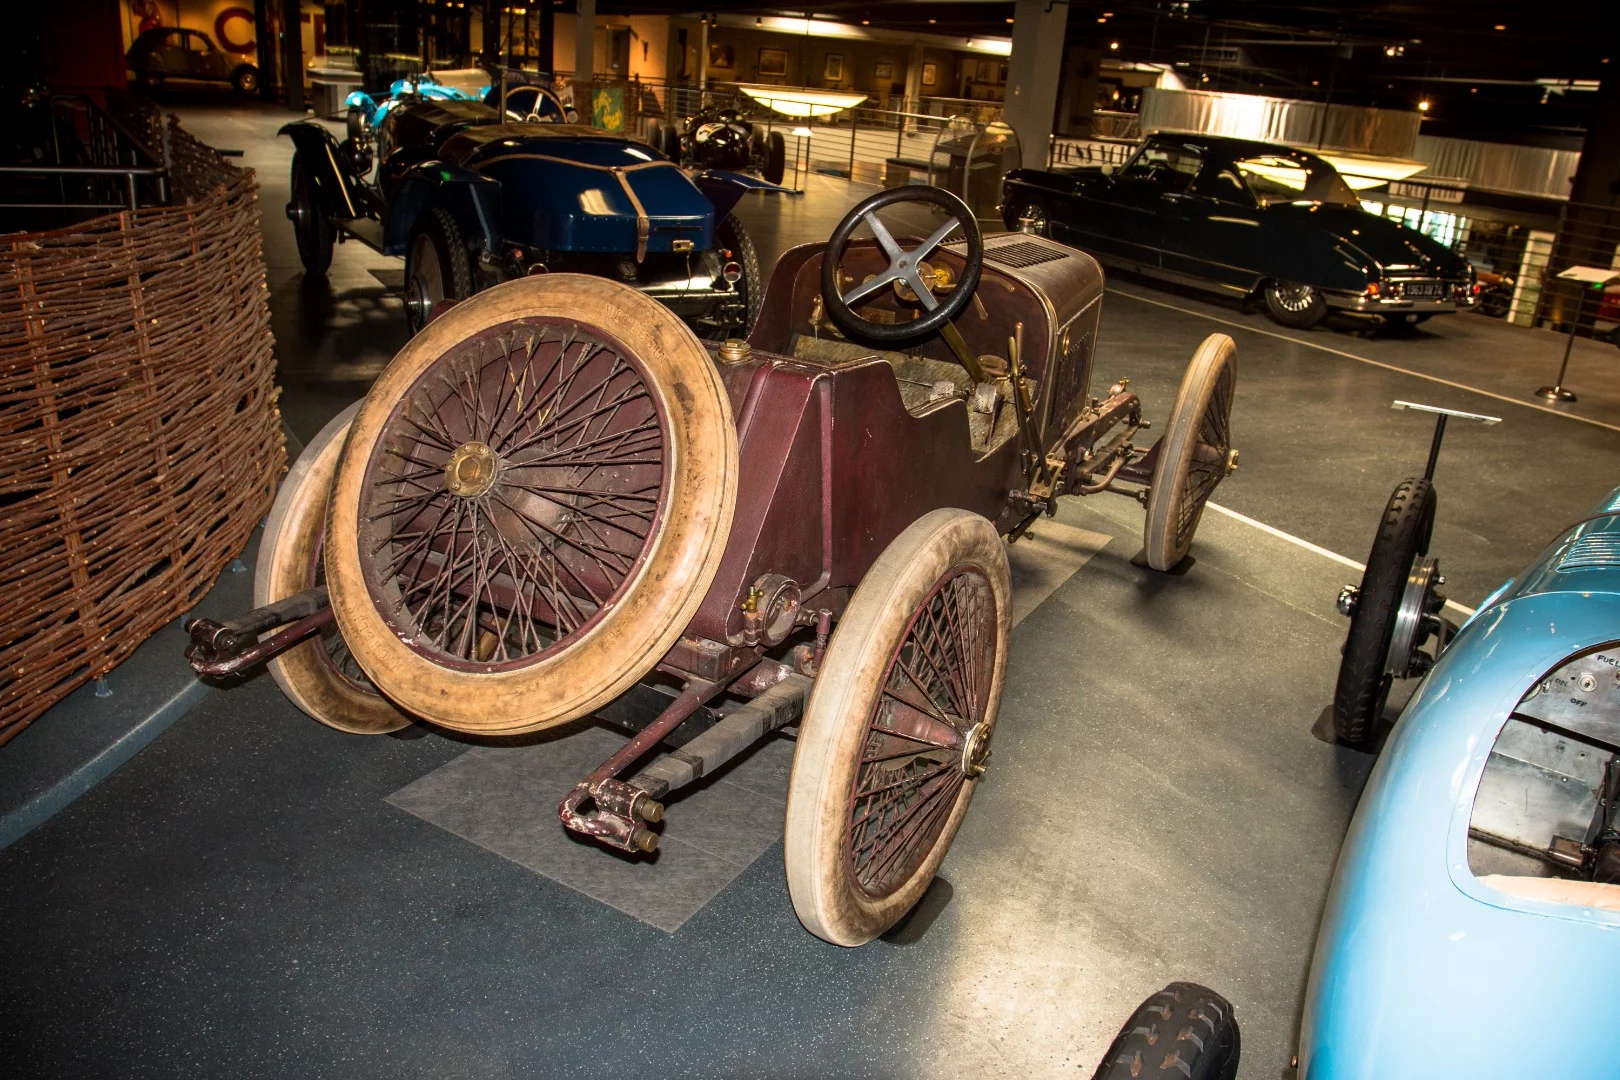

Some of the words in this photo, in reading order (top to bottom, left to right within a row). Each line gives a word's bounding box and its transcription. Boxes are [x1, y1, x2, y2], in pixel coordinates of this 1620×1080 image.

[602, 304, 669, 366] MICHELIN
[347, 603, 405, 673] MICHELIN
[1596, 654, 1620, 668] FUEL
[1570, 698, 1588, 708] OFF
